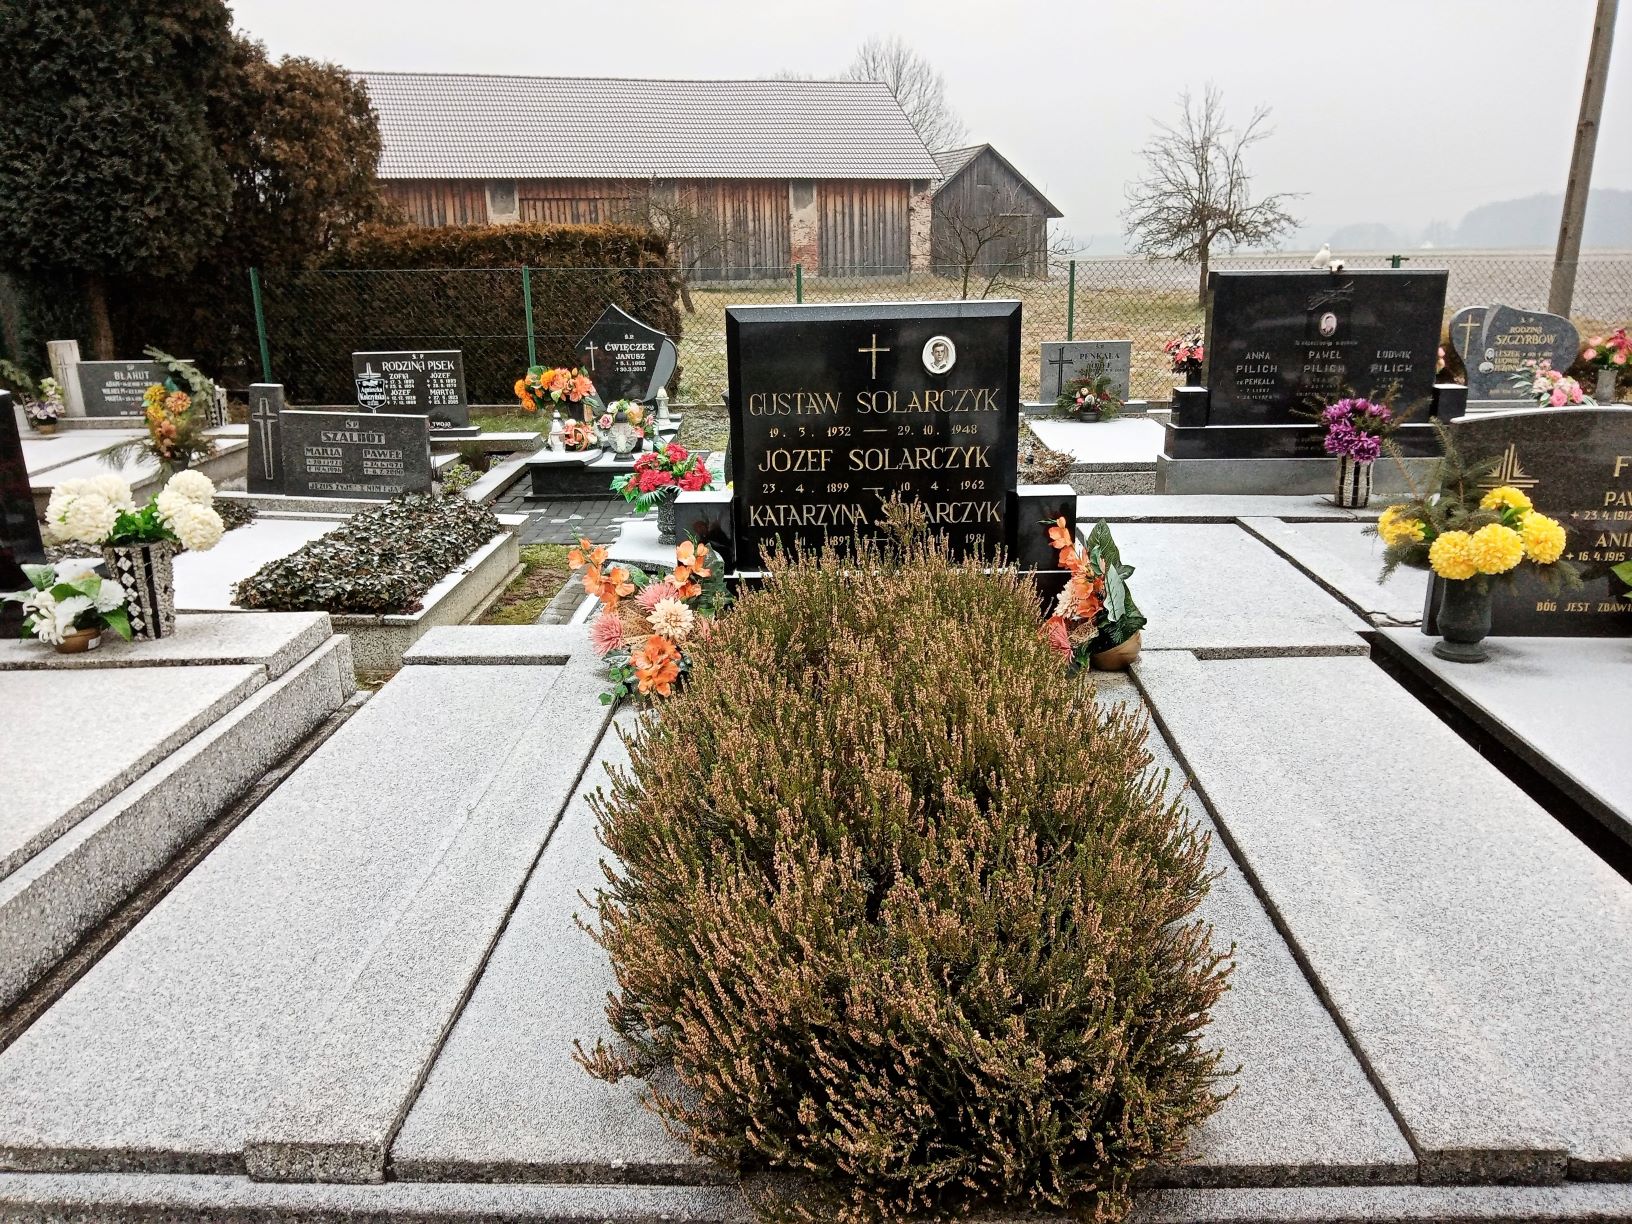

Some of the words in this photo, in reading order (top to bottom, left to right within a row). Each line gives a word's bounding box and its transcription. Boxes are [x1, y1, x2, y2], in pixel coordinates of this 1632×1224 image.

[605, 342, 655, 353] ĆWIĘCZEK
[1245, 351, 1271, 360] ANNA
[382, 361, 425, 372] RODZINA
[427, 361, 454, 371] PISEK
[1236, 365, 1278, 373] PILICH
[1303, 364, 1345, 373] PILICH
[1371, 364, 1413, 373] PILICH
[114, 371, 149, 380] BLAHUT
[430, 371, 451, 379] JÓZEF
[749, 391, 842, 416] GUSTAW
[856, 388, 1000, 414] SOLARCZYK
[826, 426, 852, 437] 1932
[951, 424, 978, 435] 1948
[304, 447, 342, 457] MARIA
[758, 447, 834, 472] JÓZEF
[848, 445, 991, 471] SOLARCZYK
[826, 482, 850, 493] 1899
[960, 479, 985, 490] 1962
[748, 503, 869, 527] KATARZYNA
[1536, 599, 1557, 612] BÓG
[1563, 602, 1590, 612] JEST
[1598, 602, 1632, 613] ZBAWI
